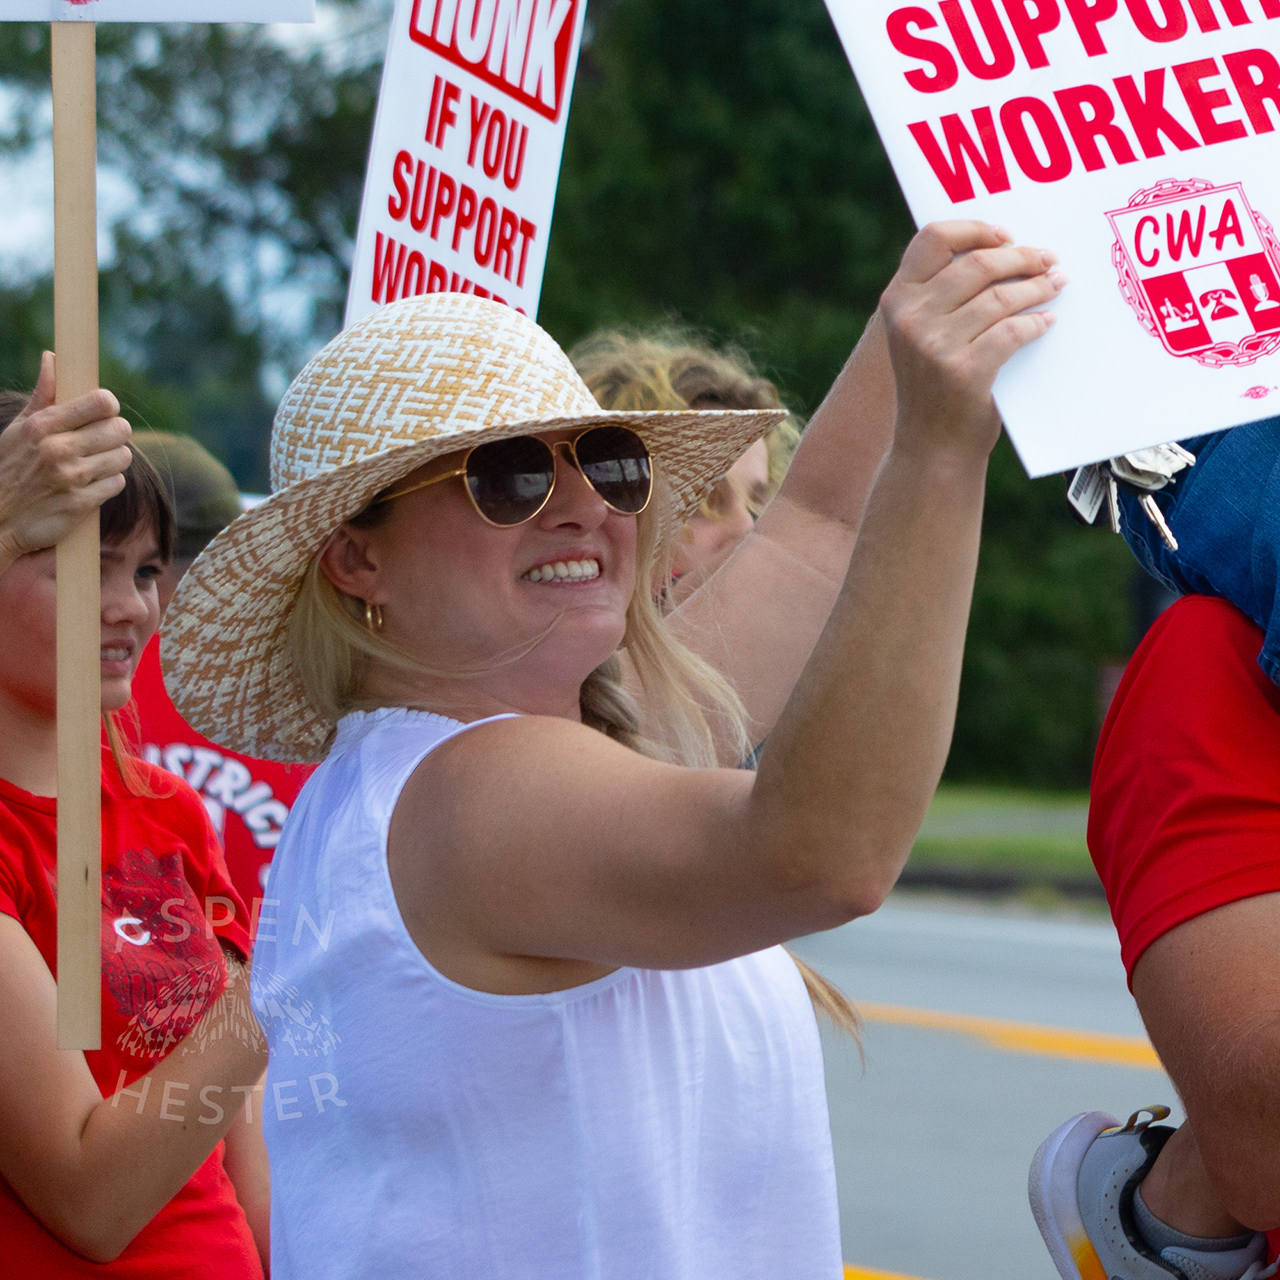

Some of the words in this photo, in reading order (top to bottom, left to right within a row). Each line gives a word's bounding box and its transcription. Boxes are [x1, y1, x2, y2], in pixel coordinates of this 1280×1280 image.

[425, 75, 462, 149] IF
[467, 95, 529, 191] YOU
[388, 150, 537, 288] SUPPORT
[1134, 199, 1245, 267] CWA
